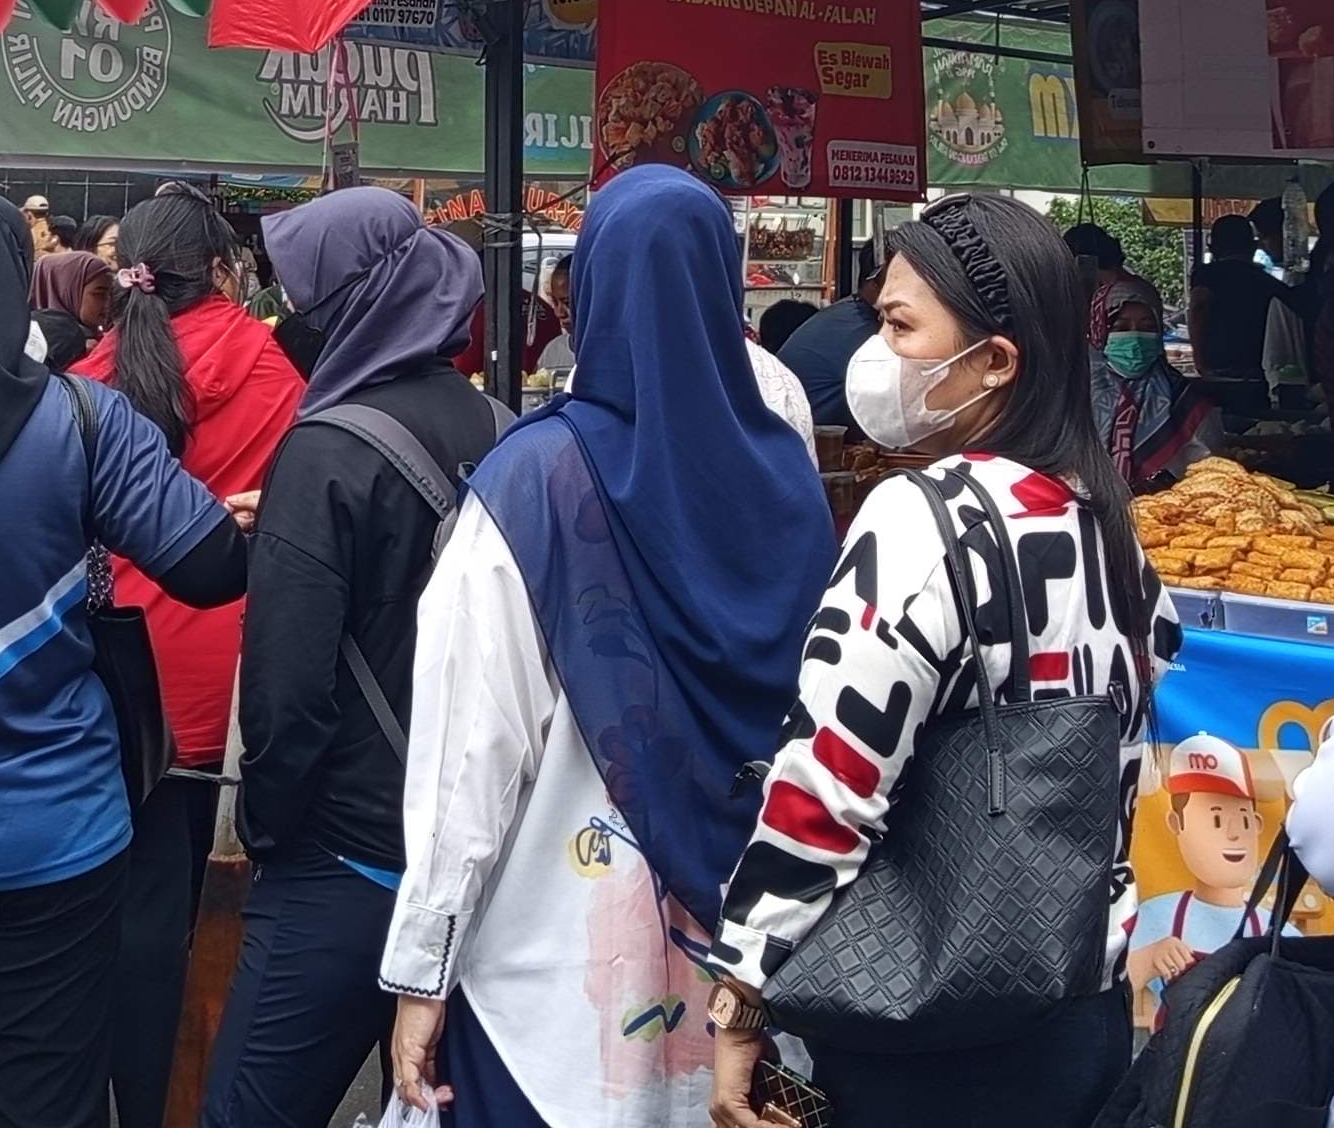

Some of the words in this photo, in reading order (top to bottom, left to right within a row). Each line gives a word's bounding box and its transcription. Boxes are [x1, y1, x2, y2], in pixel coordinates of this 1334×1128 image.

[372, 7, 395, 23] 0117
[397, 9, 434, 24] 97670
[818, 49, 838, 67] Es
[841, 50, 891, 71] Blewah
[822, 66, 871, 91] Segar
[831, 148, 880, 165] MENERIMA
[880, 151, 916, 167] PESANAN
[832, 164, 863, 182] 0812
[1188, 751, 1218, 772] mo
